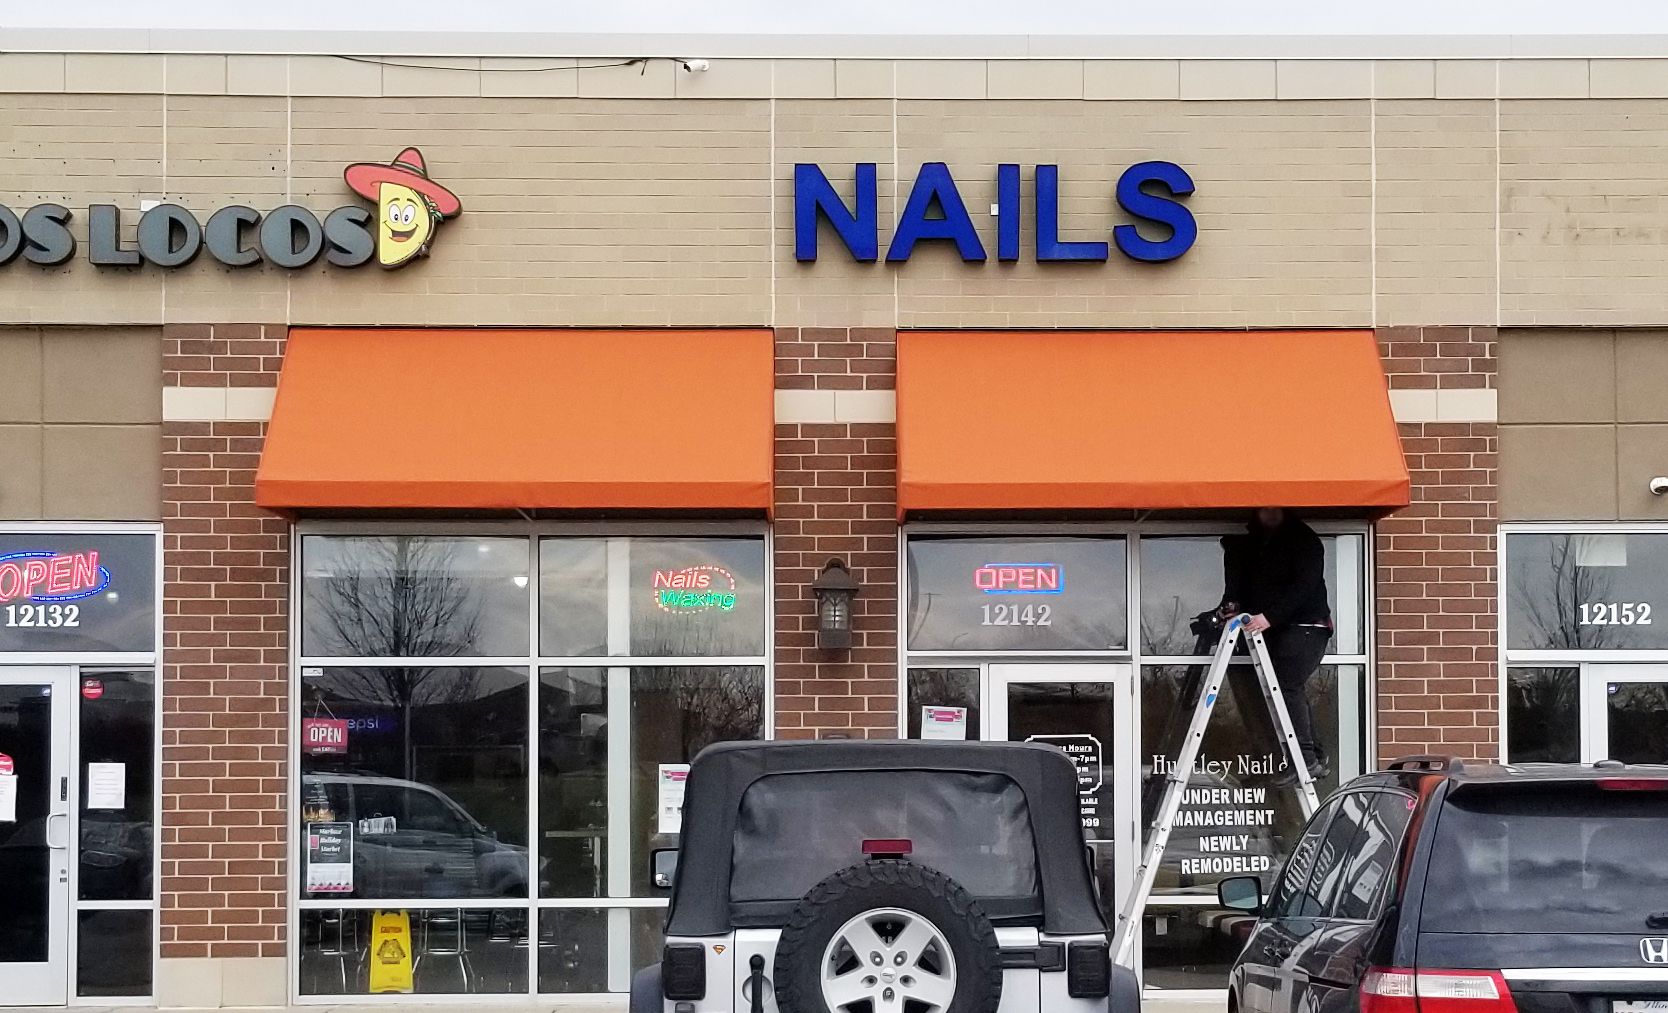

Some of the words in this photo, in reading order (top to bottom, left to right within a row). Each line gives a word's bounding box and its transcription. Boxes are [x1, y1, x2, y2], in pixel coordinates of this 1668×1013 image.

[794, 160, 1198, 264] NAILS
[89, 204, 376, 268] LOCOS
[0, 551, 98, 602] OPEN
[653, 568, 710, 589] Nails
[975, 567, 1057, 589] OPEN
[660, 589, 736, 611] Waxing
[5, 604, 80, 628] 12132
[981, 604, 1052, 626] 12142
[1579, 602, 1652, 626] 12152
[310, 727, 342, 743] OPEN
[346, 718, 380, 731] epsi
[1152, 753, 1232, 782] Hutley
[1237, 753, 1274, 775] Nail
[1181, 788, 1230, 804] UNDER
[1233, 787, 1266, 804] NEW
[1172, 809, 1275, 827] MANAGEMENT
[1199, 835, 1249, 852] NEWLY
[1181, 856, 1270, 874] REMODELED
